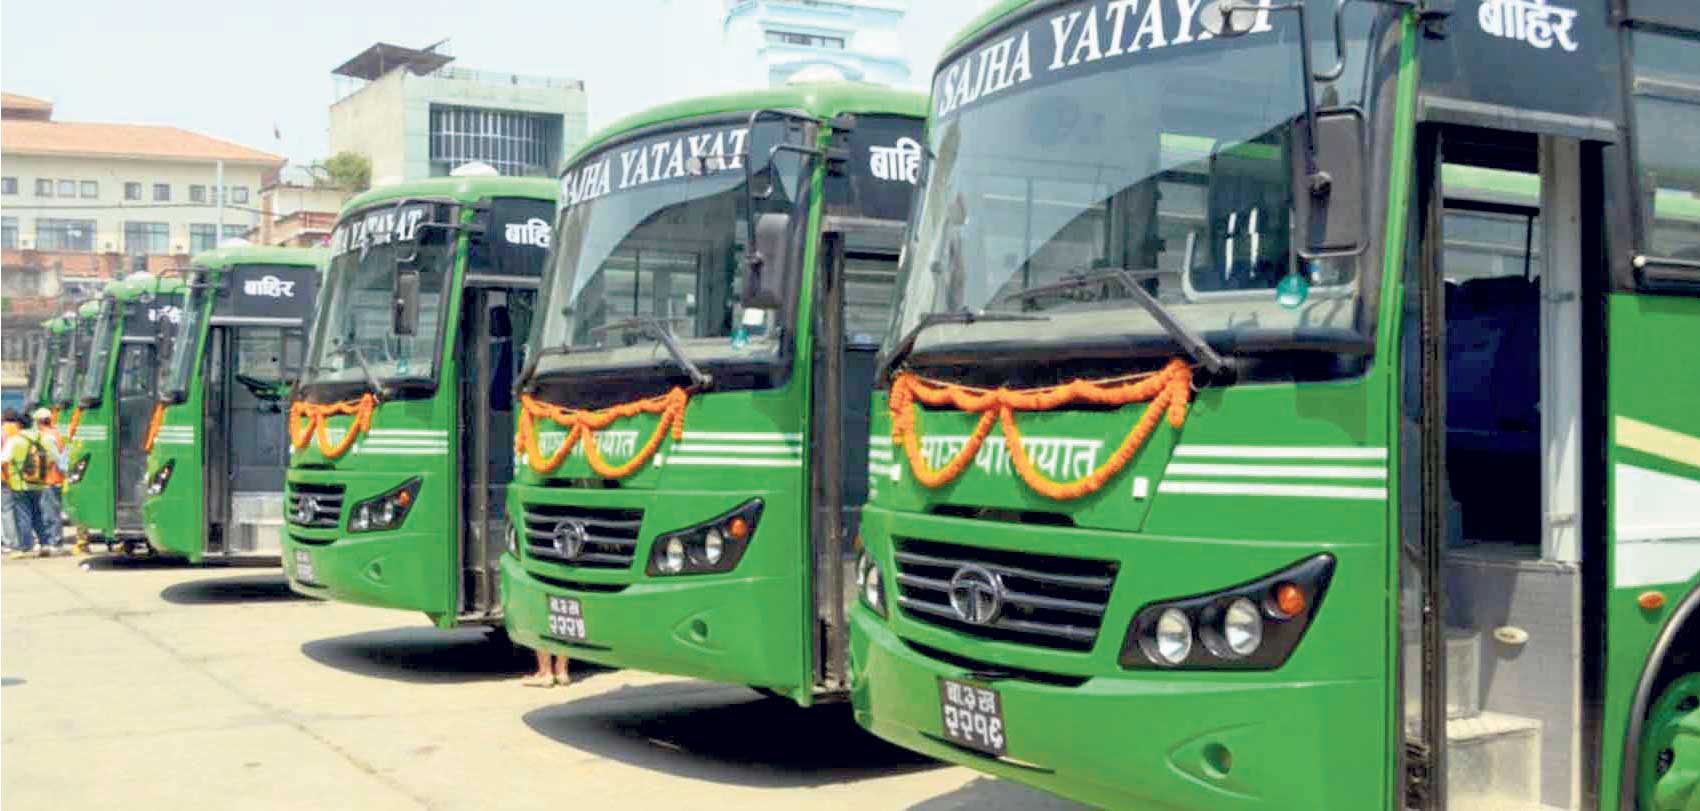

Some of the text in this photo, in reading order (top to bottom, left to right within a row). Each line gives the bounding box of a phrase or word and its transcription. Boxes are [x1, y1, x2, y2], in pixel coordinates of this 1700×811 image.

[938, 31, 1032, 117] SAJHA
[869, 137, 922, 184] बाहि
[505, 218, 552, 248] बाहि
